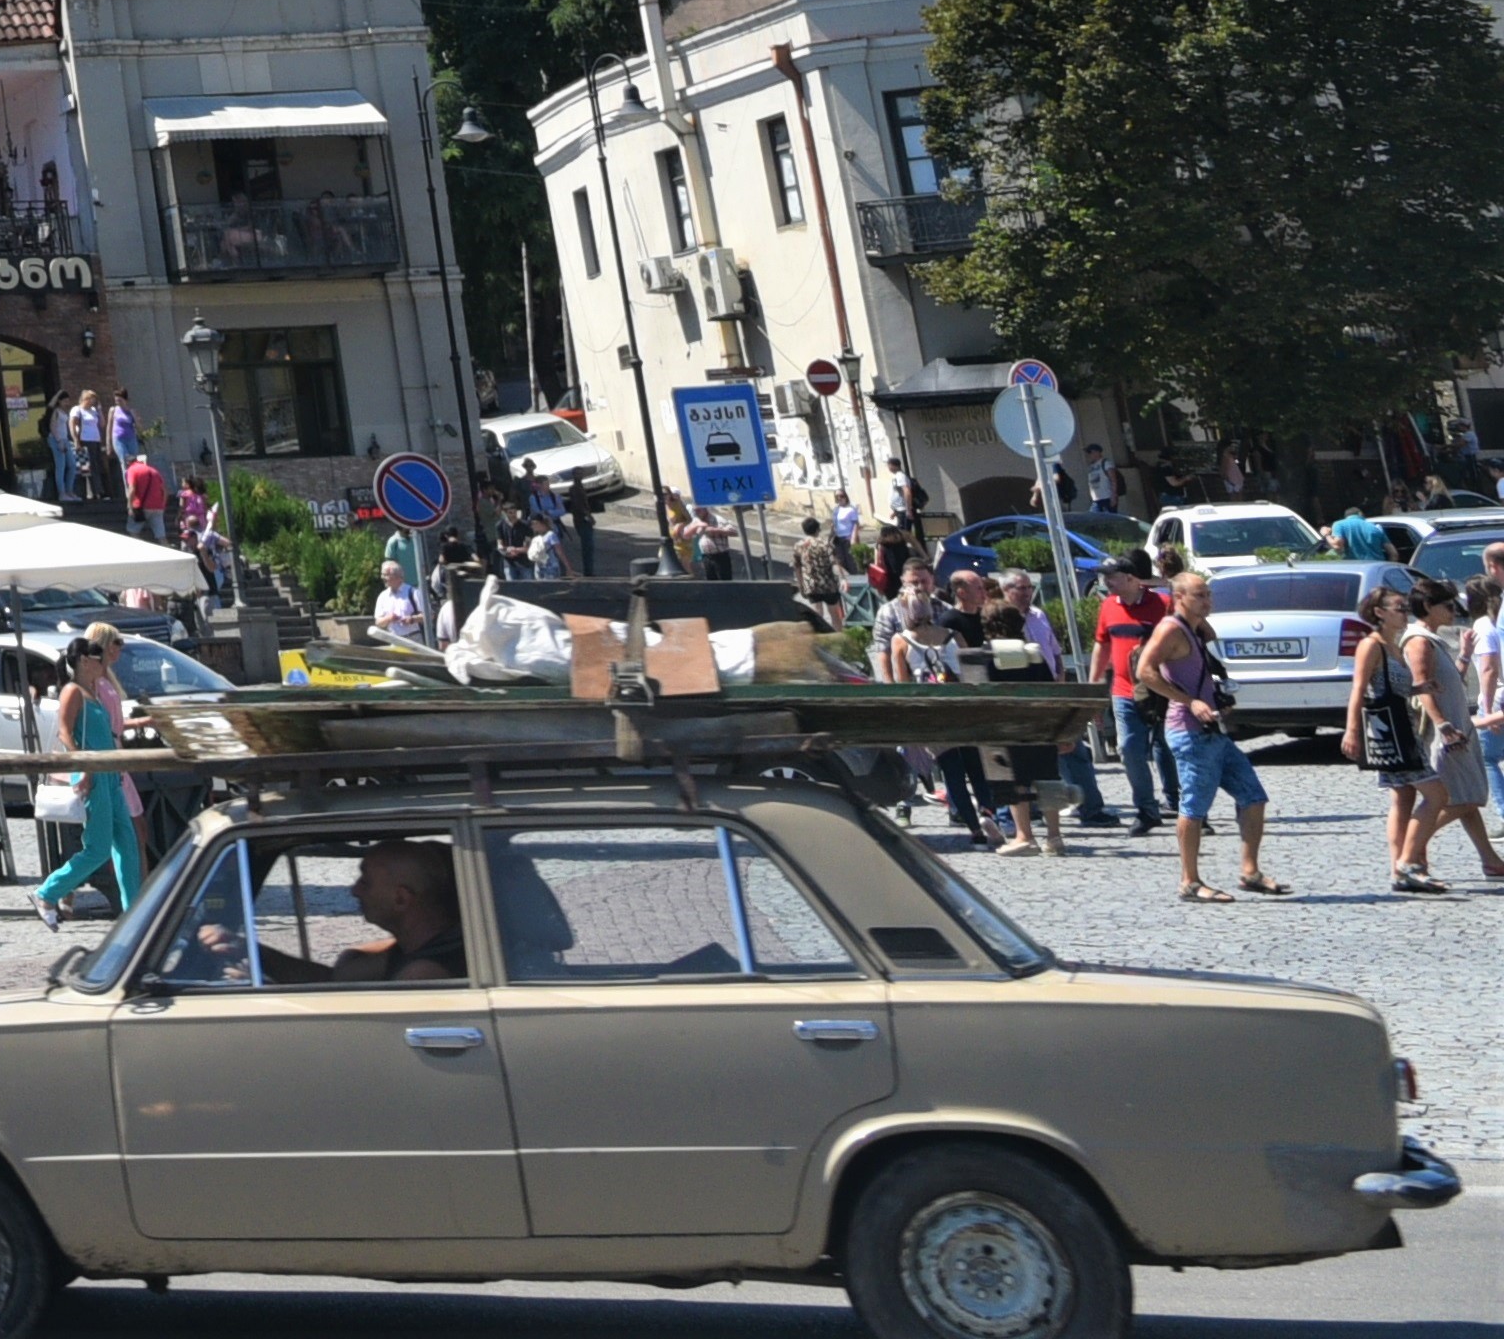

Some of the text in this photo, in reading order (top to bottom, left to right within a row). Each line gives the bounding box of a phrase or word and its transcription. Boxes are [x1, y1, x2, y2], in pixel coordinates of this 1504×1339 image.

[689, 405, 746, 422] ტაქსი
[923, 428, 996, 449] STRIP CLU
[708, 476, 755, 493] TAXI
[1235, 642, 1292, 654] PL-774-LP
